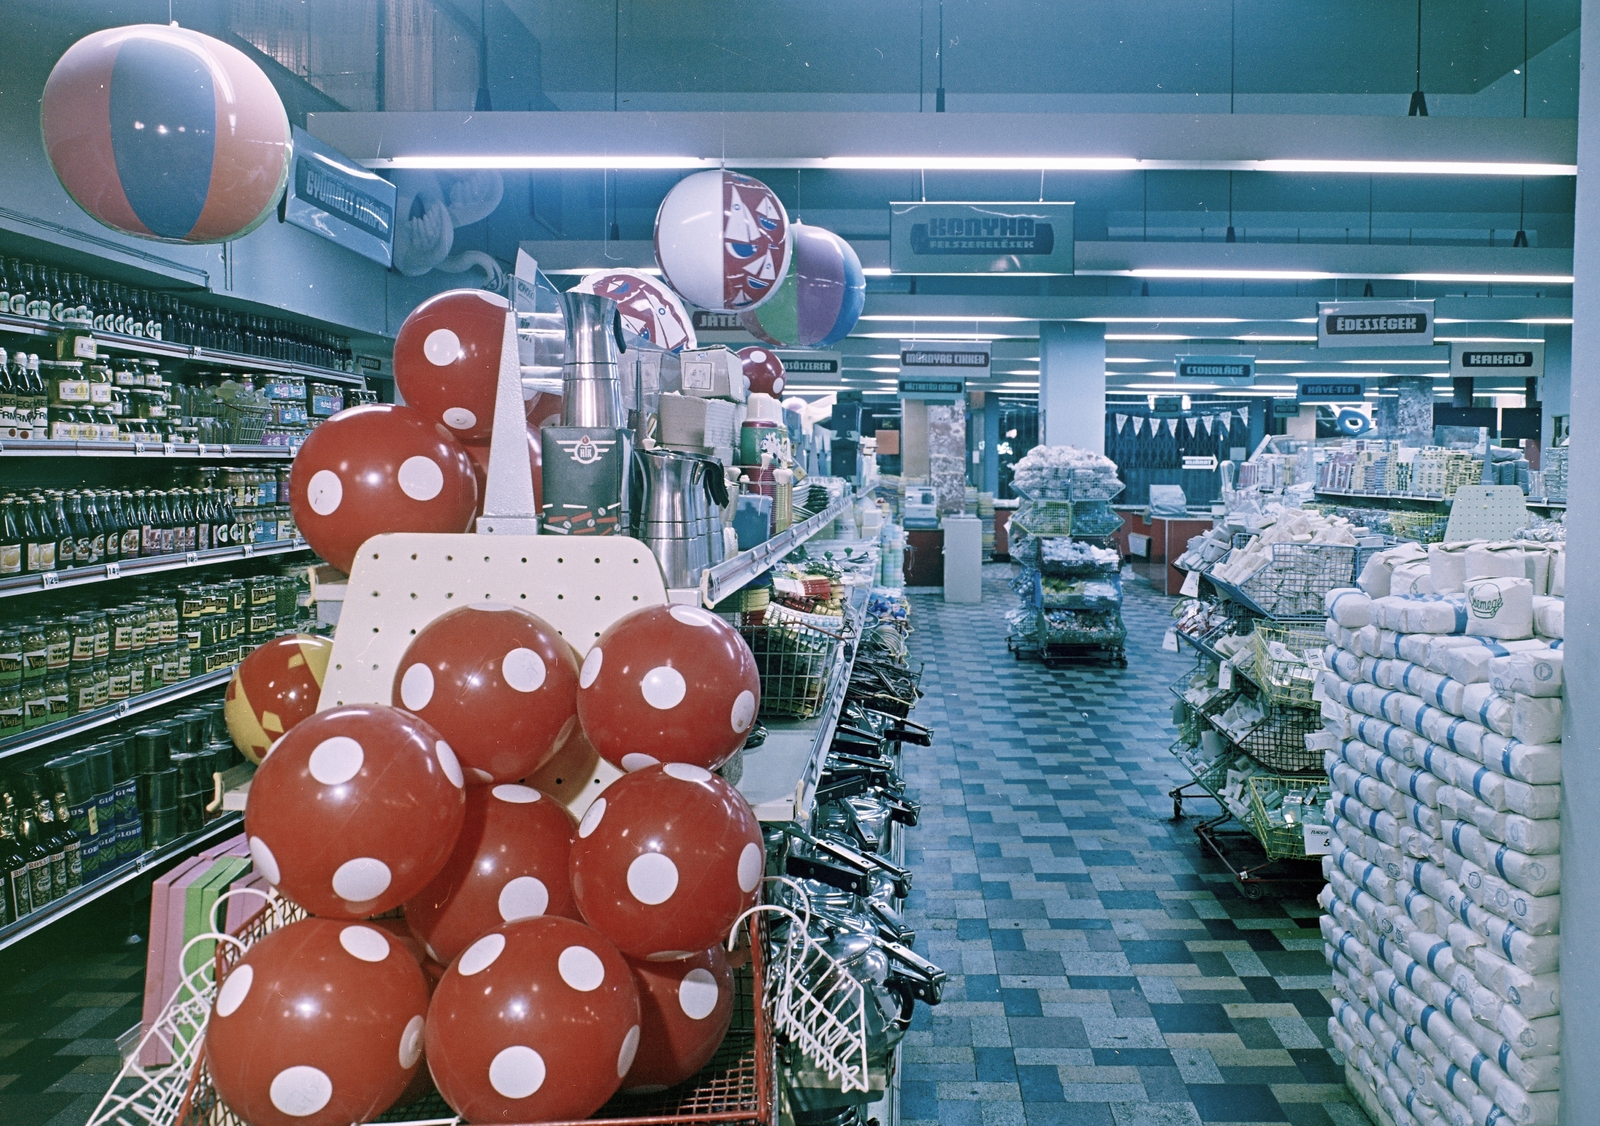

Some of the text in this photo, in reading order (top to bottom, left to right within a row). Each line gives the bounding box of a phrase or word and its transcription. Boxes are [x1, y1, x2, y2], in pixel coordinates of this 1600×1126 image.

[929, 217, 1036, 237] KONYHA
[929, 238, 1034, 249] FELSZERELÉSEK
[1336, 317, 1417, 332] ÉDESSÉGEK
[953, 353, 986, 365] CIKKEK
[1469, 353, 1526, 364] KAKAÓ
[782, 361, 832, 371] OSÓSZEREK
[1186, 365, 1245, 376] CSOKOLÁDÉ
